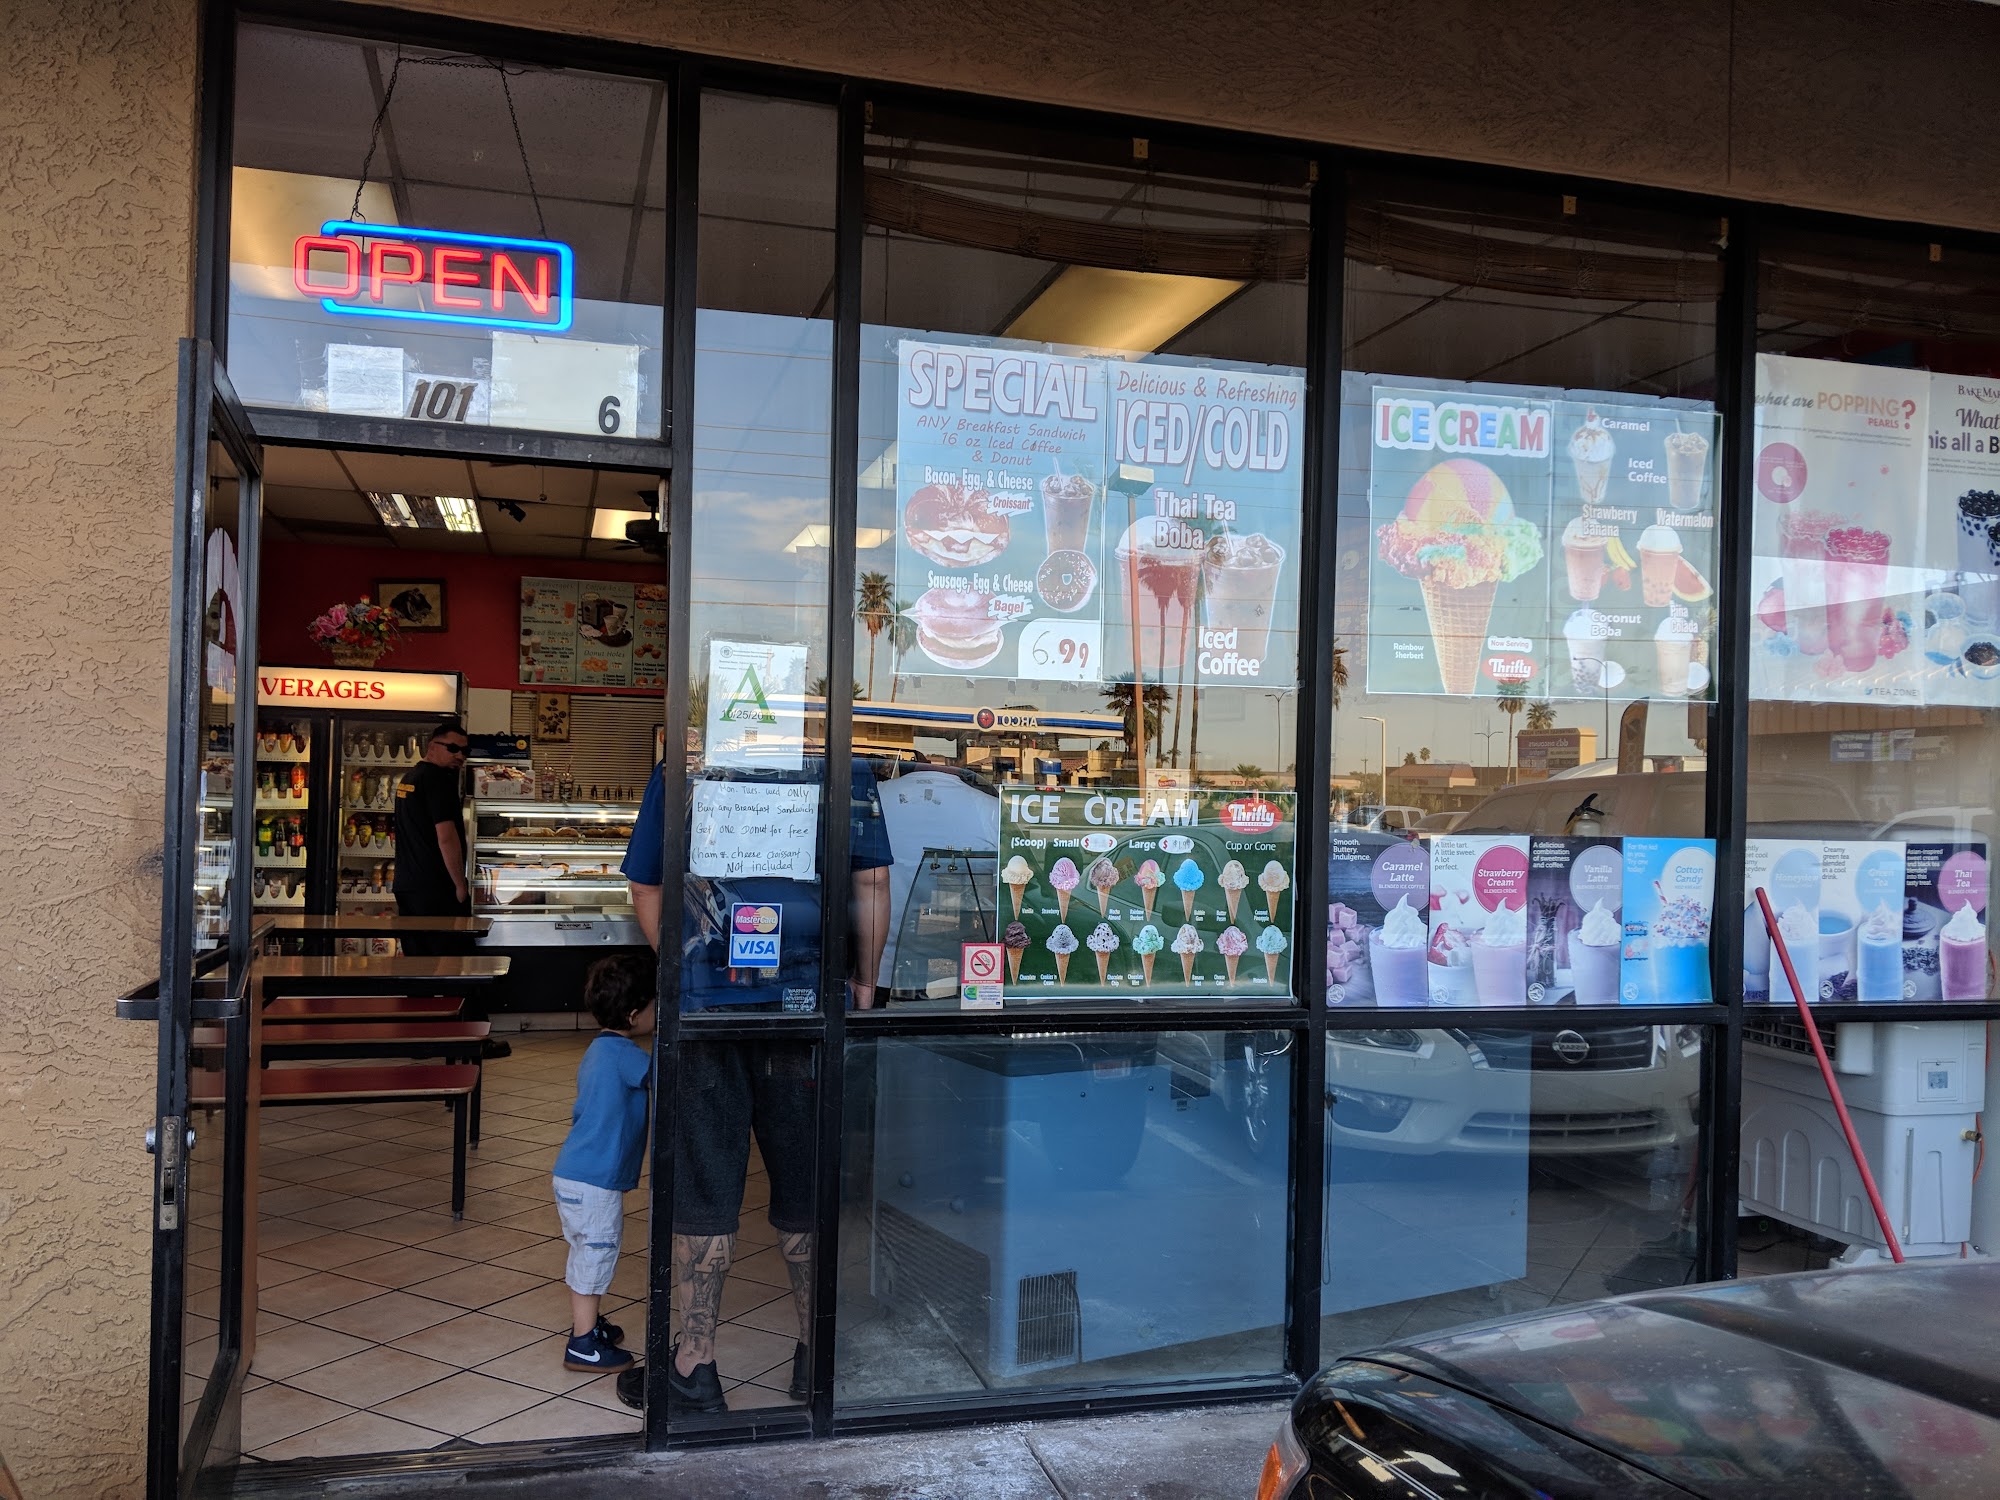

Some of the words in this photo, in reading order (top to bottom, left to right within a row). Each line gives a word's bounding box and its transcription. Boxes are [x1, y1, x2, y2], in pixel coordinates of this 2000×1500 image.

[294, 235, 550, 314] OPEN
[908, 350, 1098, 421] SPECIAL
[1116, 370, 1186, 397] Delicious
[1193, 376, 1207, 397] &
[1216, 377, 1298, 411] Refreshing
[406, 378, 478, 422] 101
[1792, 396, 1814, 409] are
[598, 395, 621, 435] 6
[917, 415, 950, 431] ANY
[956, 418, 1021, 436] Breakfast
[1028, 423, 1087, 442] Sandwich
[1381, 404, 1430, 444] ICE
[1439, 407, 1545, 451] CREAM
[1601, 417, 1650, 432] Caramel
[1868, 417, 1900, 430] PEARLS
[941, 432, 957, 446] 16
[965, 437, 980, 449] oz
[988, 436, 1013, 451] Iced
[1021, 437, 1062, 454] Coffee
[1115, 398, 1290, 485] ICED/COLD
[1951, 432, 1970, 452] all
[1975, 439, 1984, 453] a
[990, 450, 1033, 467] Donut
[1628, 458, 1654, 470] Iced
[924, 465, 960, 488] Bacon,
[961, 470, 985, 492] Egg,
[986, 470, 995, 488] &
[997, 470, 1034, 492] Cheese
[1628, 471, 1667, 485] Coffee
[992, 495, 1031, 511] Croissant
[1156, 488, 1199, 520] Thai
[1203, 492, 1237, 521] Tea
[1582, 503, 1638, 524] Strawberry
[1656, 508, 1714, 528] Watermelon
[1583, 521, 1619, 537] Banana
[1154, 521, 1206, 552] Boba
[927, 569, 970, 593] Sausage,
[972, 573, 990, 593] Egg
[992, 575, 1001, 591] &
[1002, 575, 1034, 593] Cheese
[993, 599, 1024, 616] Bagel
[1591, 612, 1641, 625] Coconut
[1591, 625, 1622, 638] Boba
[1671, 619, 1699, 633] Colada
[1198, 625, 1238, 650] Iced
[1490, 639, 1505, 647] Now
[1506, 640, 1530, 649] Serving
[1393, 642, 1424, 651] Rainbow
[1197, 651, 1260, 677] Coffee
[1488, 657, 1532, 676] Thrifty
[719, 663, 777, 724] A
[1010, 794, 1061, 824] ICE
[1083, 795, 1199, 827] CREAM
[1228, 803, 1274, 823] Thrifty
[1010, 837, 1047, 850] (Scoop)
[1052, 837, 1079, 848] Small
[1128, 839, 1156, 851] Large
[1225, 841, 1242, 852] Cup
[1243, 842, 1253, 850] or
[1254, 841, 1276, 851] Cone
[1333, 838, 1360, 846] Smooth.
[1333, 846, 1359, 854] Buttery.
[1823, 846, 1846, 854] Creamy
[1333, 853, 1371, 862] Indulgence.
[1381, 861, 1423, 871] Caramel
[1584, 864, 1613, 873] Vanilla
[1675, 865, 1704, 874] Cotton
[1389, 873, 1415, 882] Latte
[1477, 868, 1525, 879] Strawberry
[1587, 874, 1609, 883] Latte
[1675, 874, 1703, 885] Candy
[1775, 873, 1819, 883] Honeydew
[1955, 869, 1973, 878] Thai
[1487, 878, 1515, 887] Cream
[1874, 879, 1888, 887] Tea
[1956, 879, 1971, 888] Tea
[735, 915, 777, 925] MasterCard
[738, 940, 776, 955] VISA
